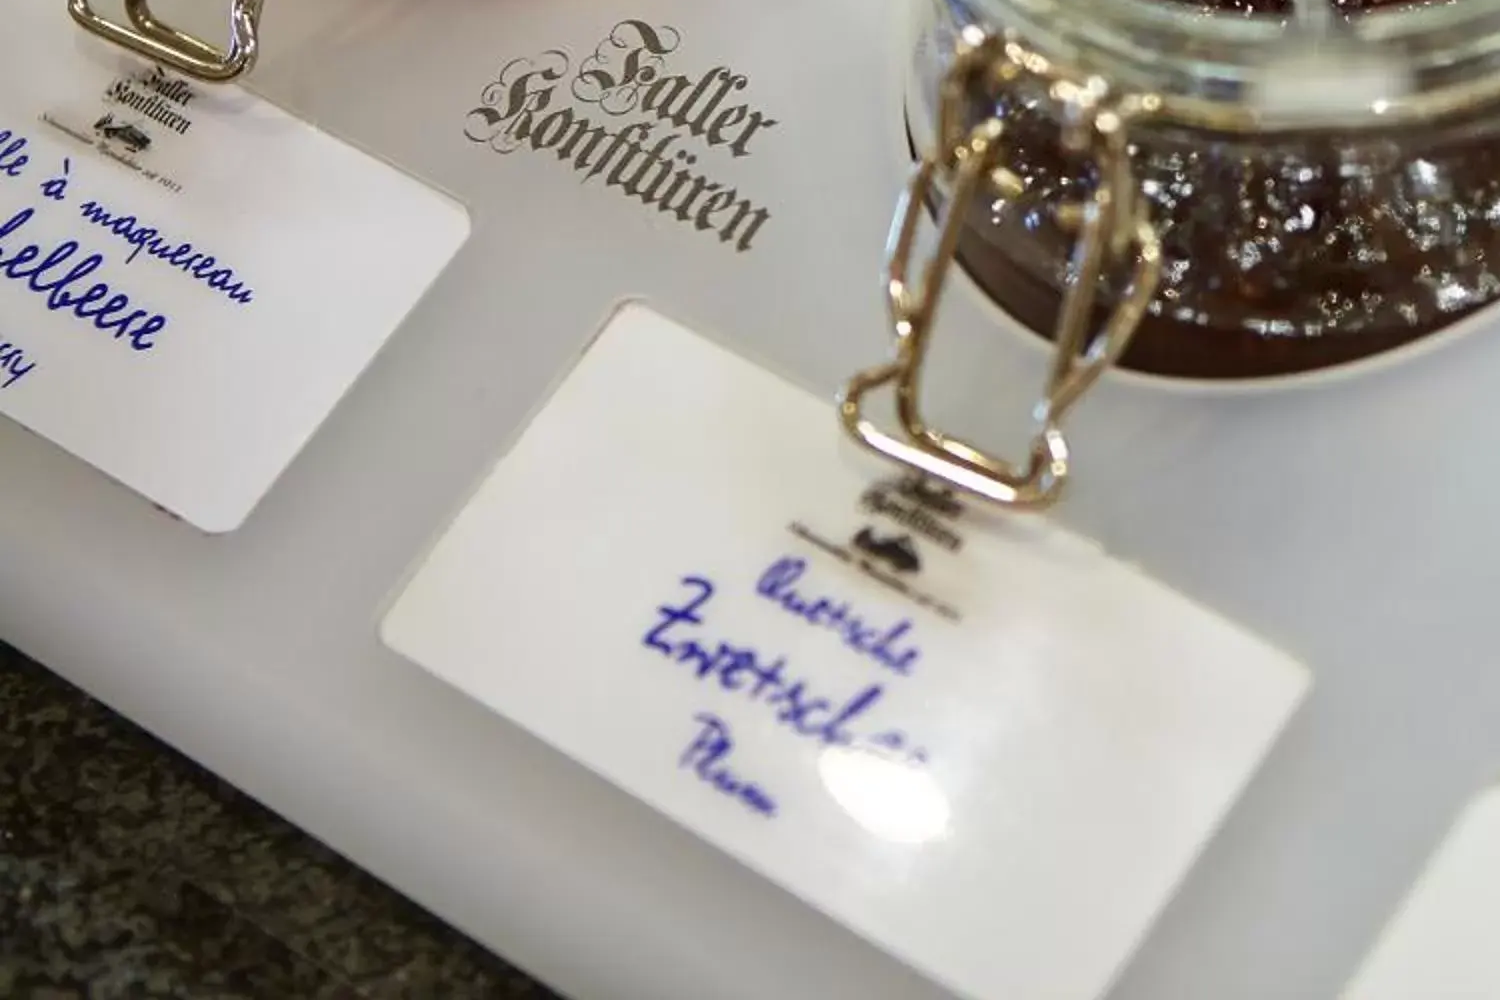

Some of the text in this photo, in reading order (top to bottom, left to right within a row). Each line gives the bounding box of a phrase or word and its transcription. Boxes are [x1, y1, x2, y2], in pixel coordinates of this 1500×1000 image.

[463, 49, 772, 253] Konfitüren
[571, 19, 779, 157] Faller
[41, 158, 70, 200] à
